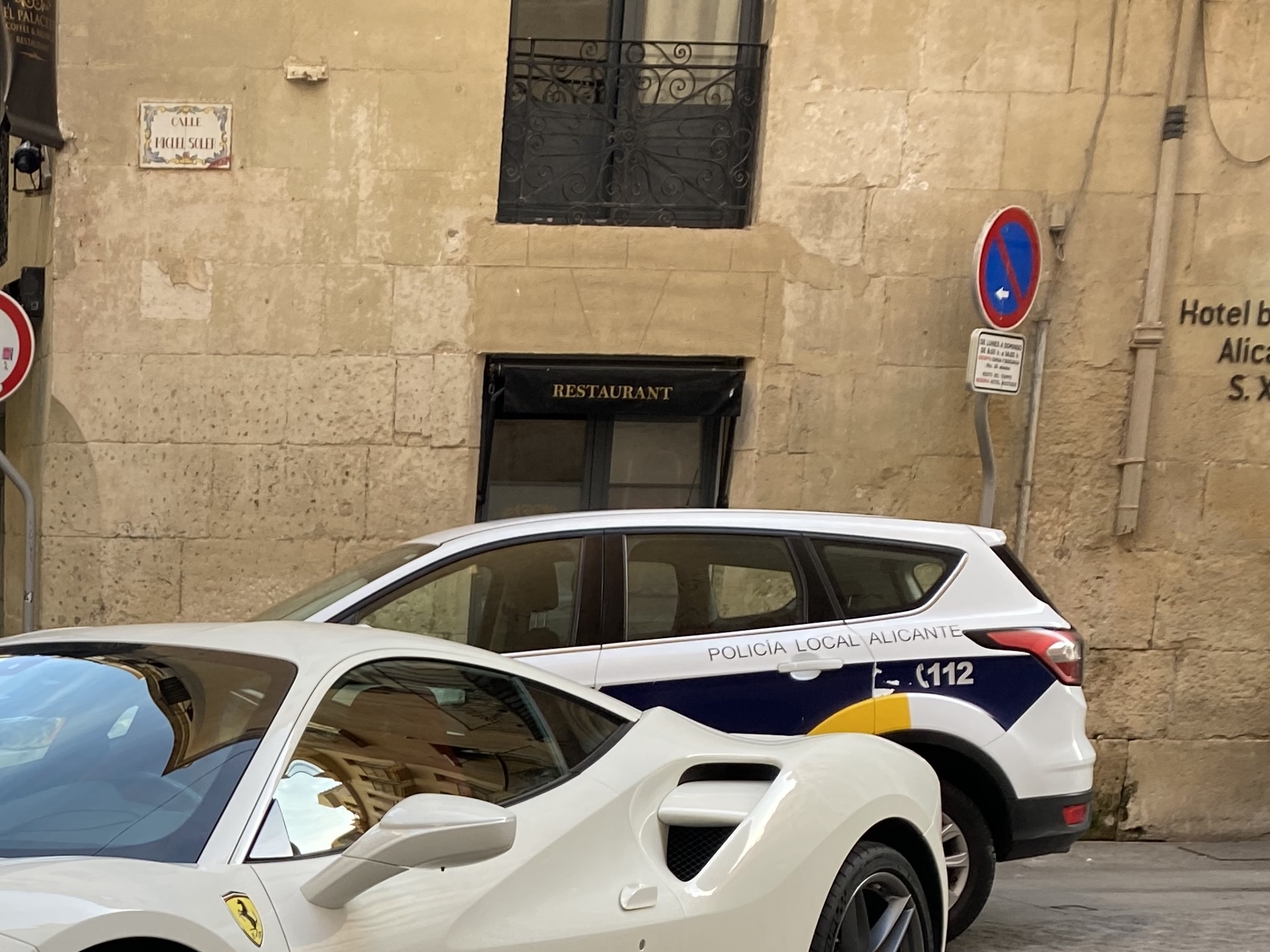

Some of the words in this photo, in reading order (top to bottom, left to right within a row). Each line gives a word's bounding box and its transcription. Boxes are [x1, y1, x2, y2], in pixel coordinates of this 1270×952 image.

[171, 116, 202, 127] CALLE
[155, 137, 185, 149] MIGUEL
[188, 137, 216, 150] SOLER
[1179, 298, 1251, 326] Hotel
[552, 383, 674, 401] RESTAURANT
[1228, 373, 1251, 401] S.
[708, 639, 787, 662] POLICÍA
[795, 634, 861, 652] LOCAL
[869, 624, 963, 645] ALICANTE
[928, 661, 975, 686] 112
